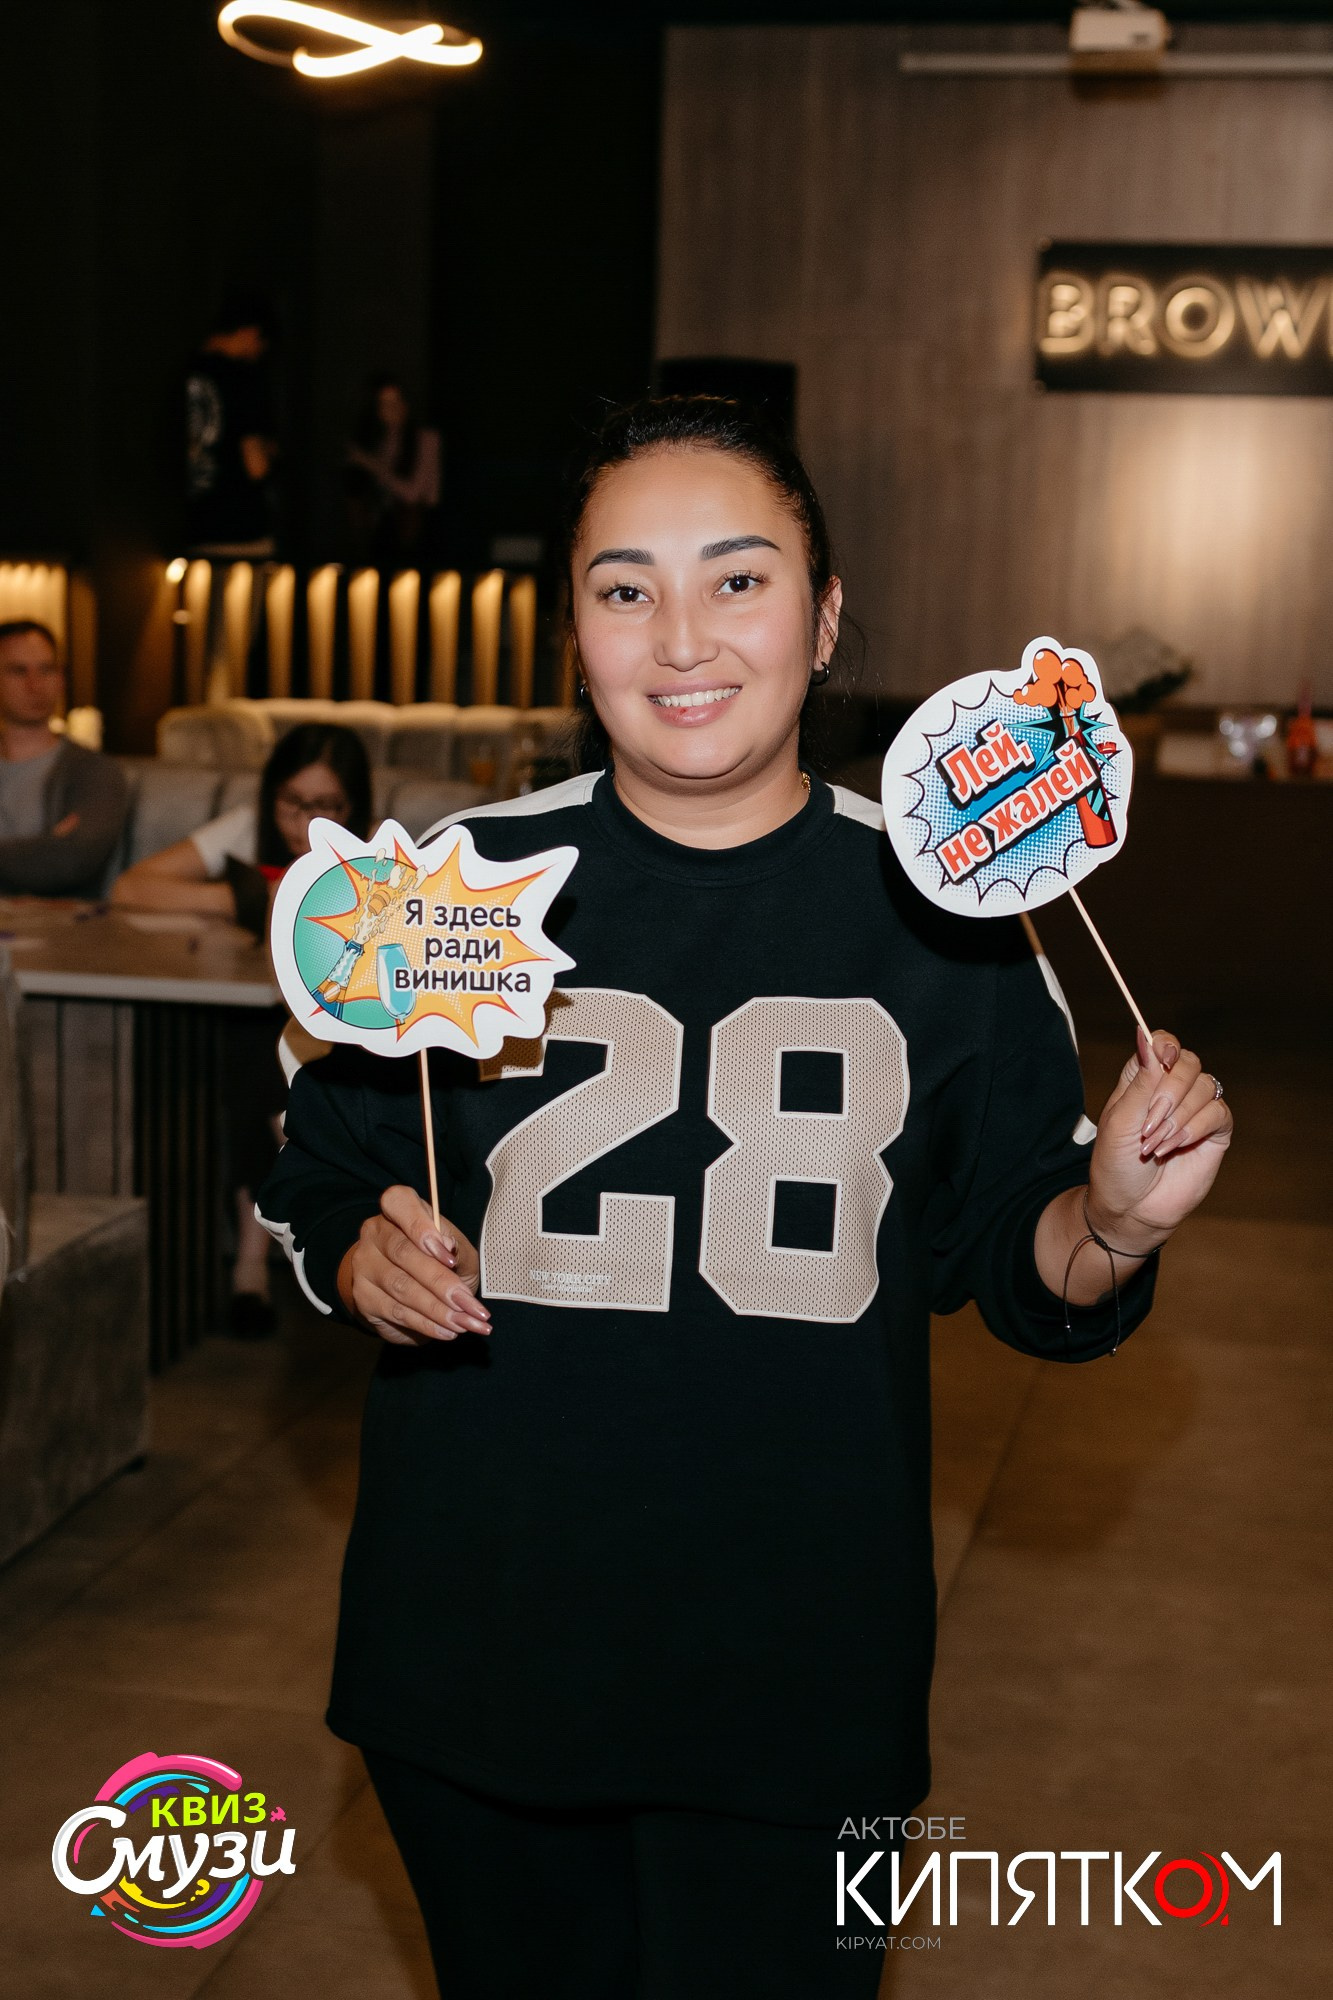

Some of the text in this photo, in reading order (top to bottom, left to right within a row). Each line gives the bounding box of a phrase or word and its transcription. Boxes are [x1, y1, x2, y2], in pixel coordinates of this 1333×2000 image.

[1039, 270, 1333, 359] BROW
[944, 722, 1034, 798] Лей,
[940, 740, 1095, 876] не жалей
[405, 899, 521, 932] Я здесь
[424, 937, 501, 964] ради
[394, 968, 531, 992] винишка
[479, 986, 910, 1323] 28
[529, 1269, 612, 1286] NEW YORK CITY
